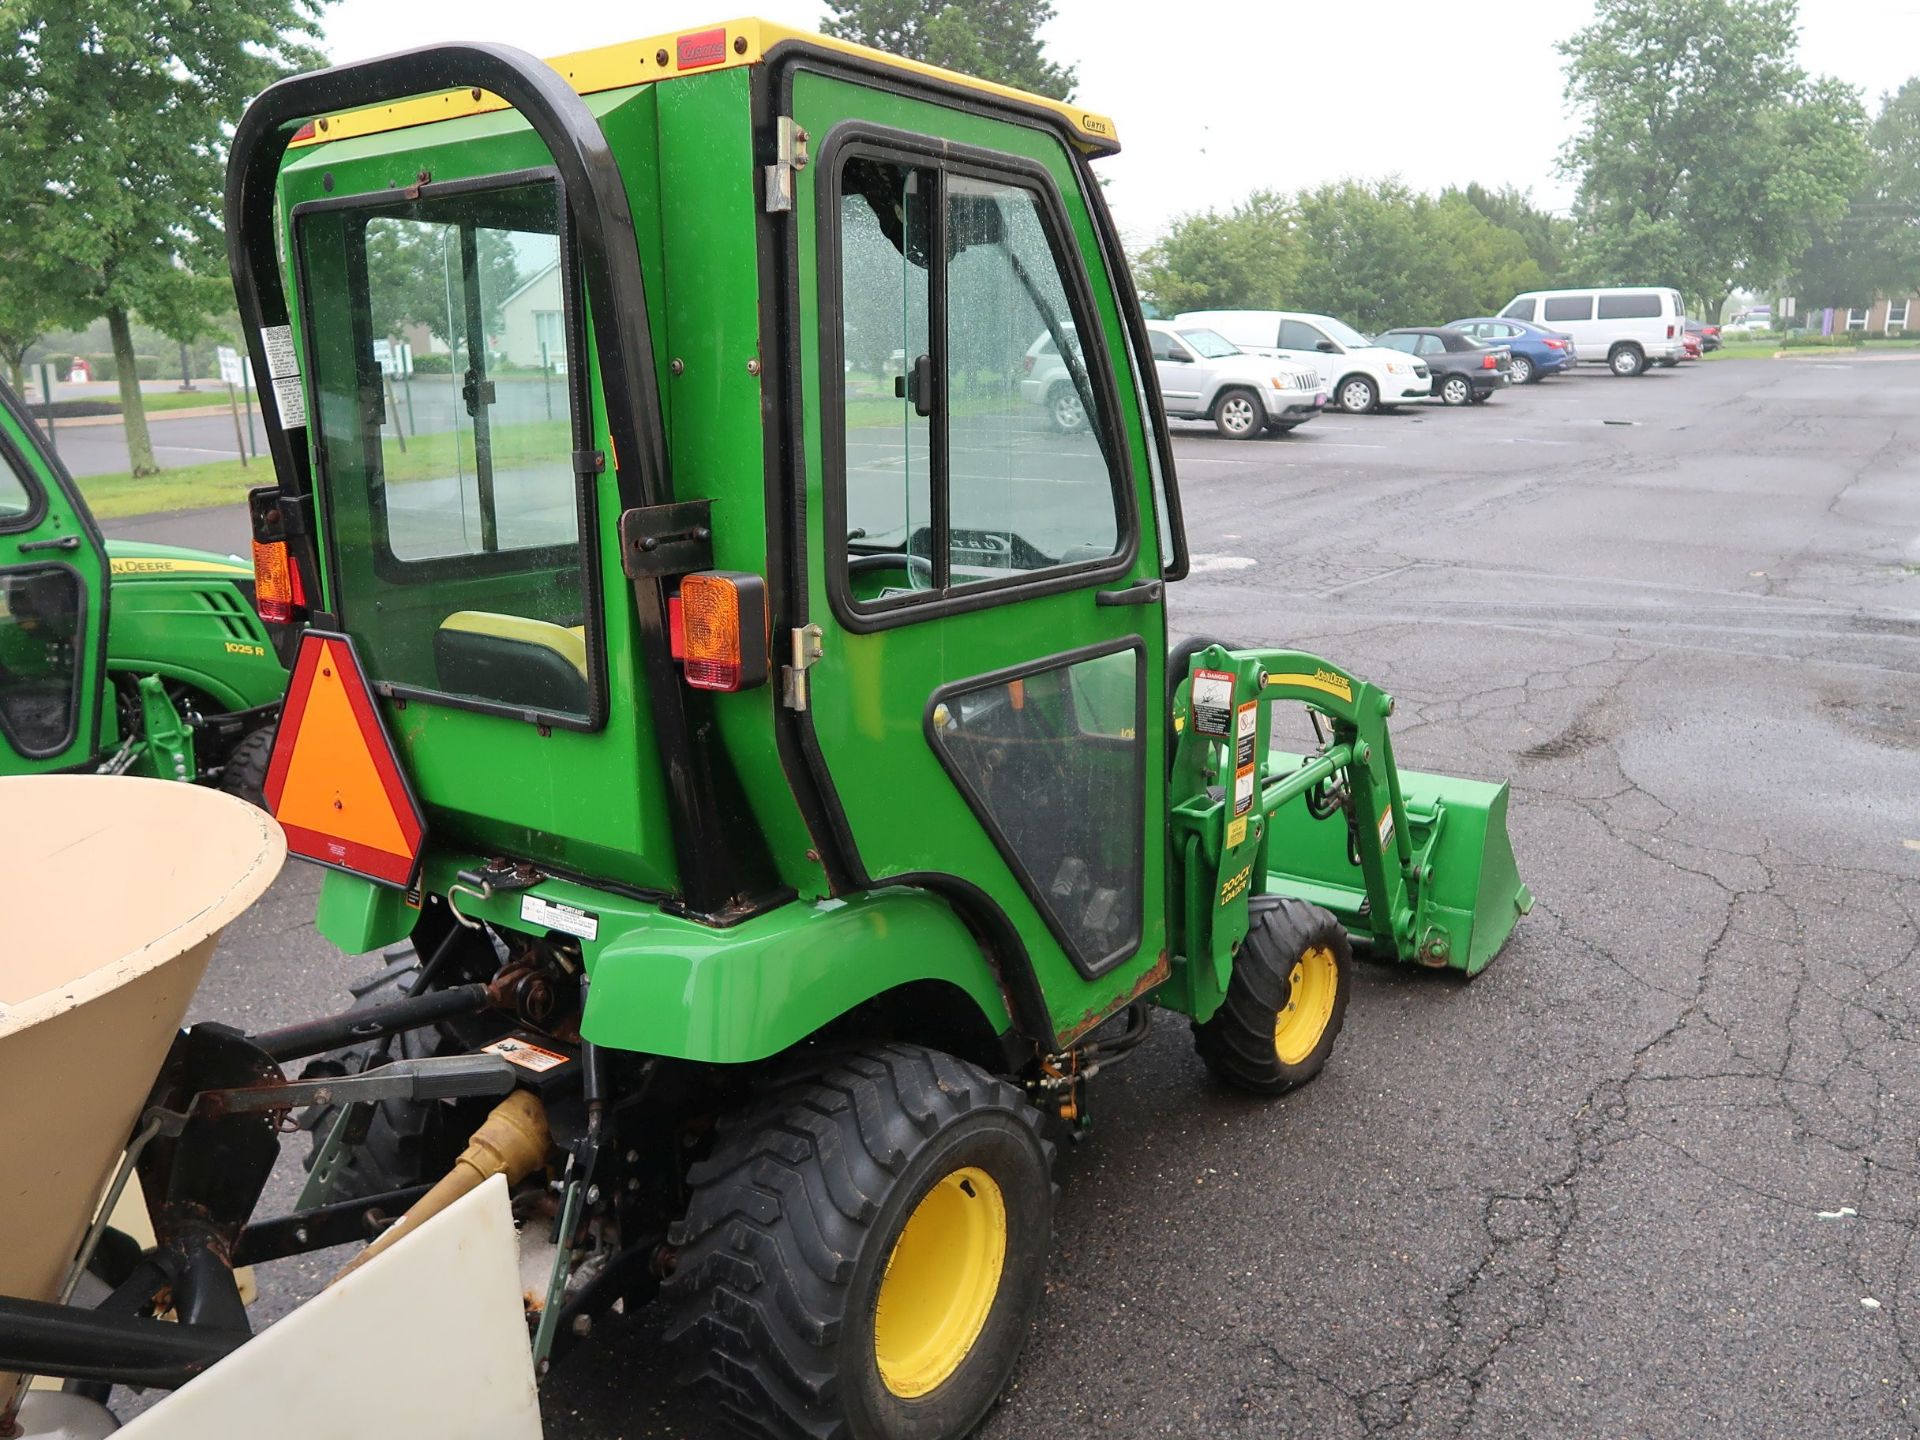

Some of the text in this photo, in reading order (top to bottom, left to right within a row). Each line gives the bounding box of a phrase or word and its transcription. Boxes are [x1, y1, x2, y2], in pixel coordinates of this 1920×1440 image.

[1082, 114, 1106, 133] CURTIS
[125, 561, 174, 571] DEERE
[224, 642, 253, 654] 1025
[1206, 672, 1229, 681] DANGER
[1221, 880, 1247, 906] LOADER
